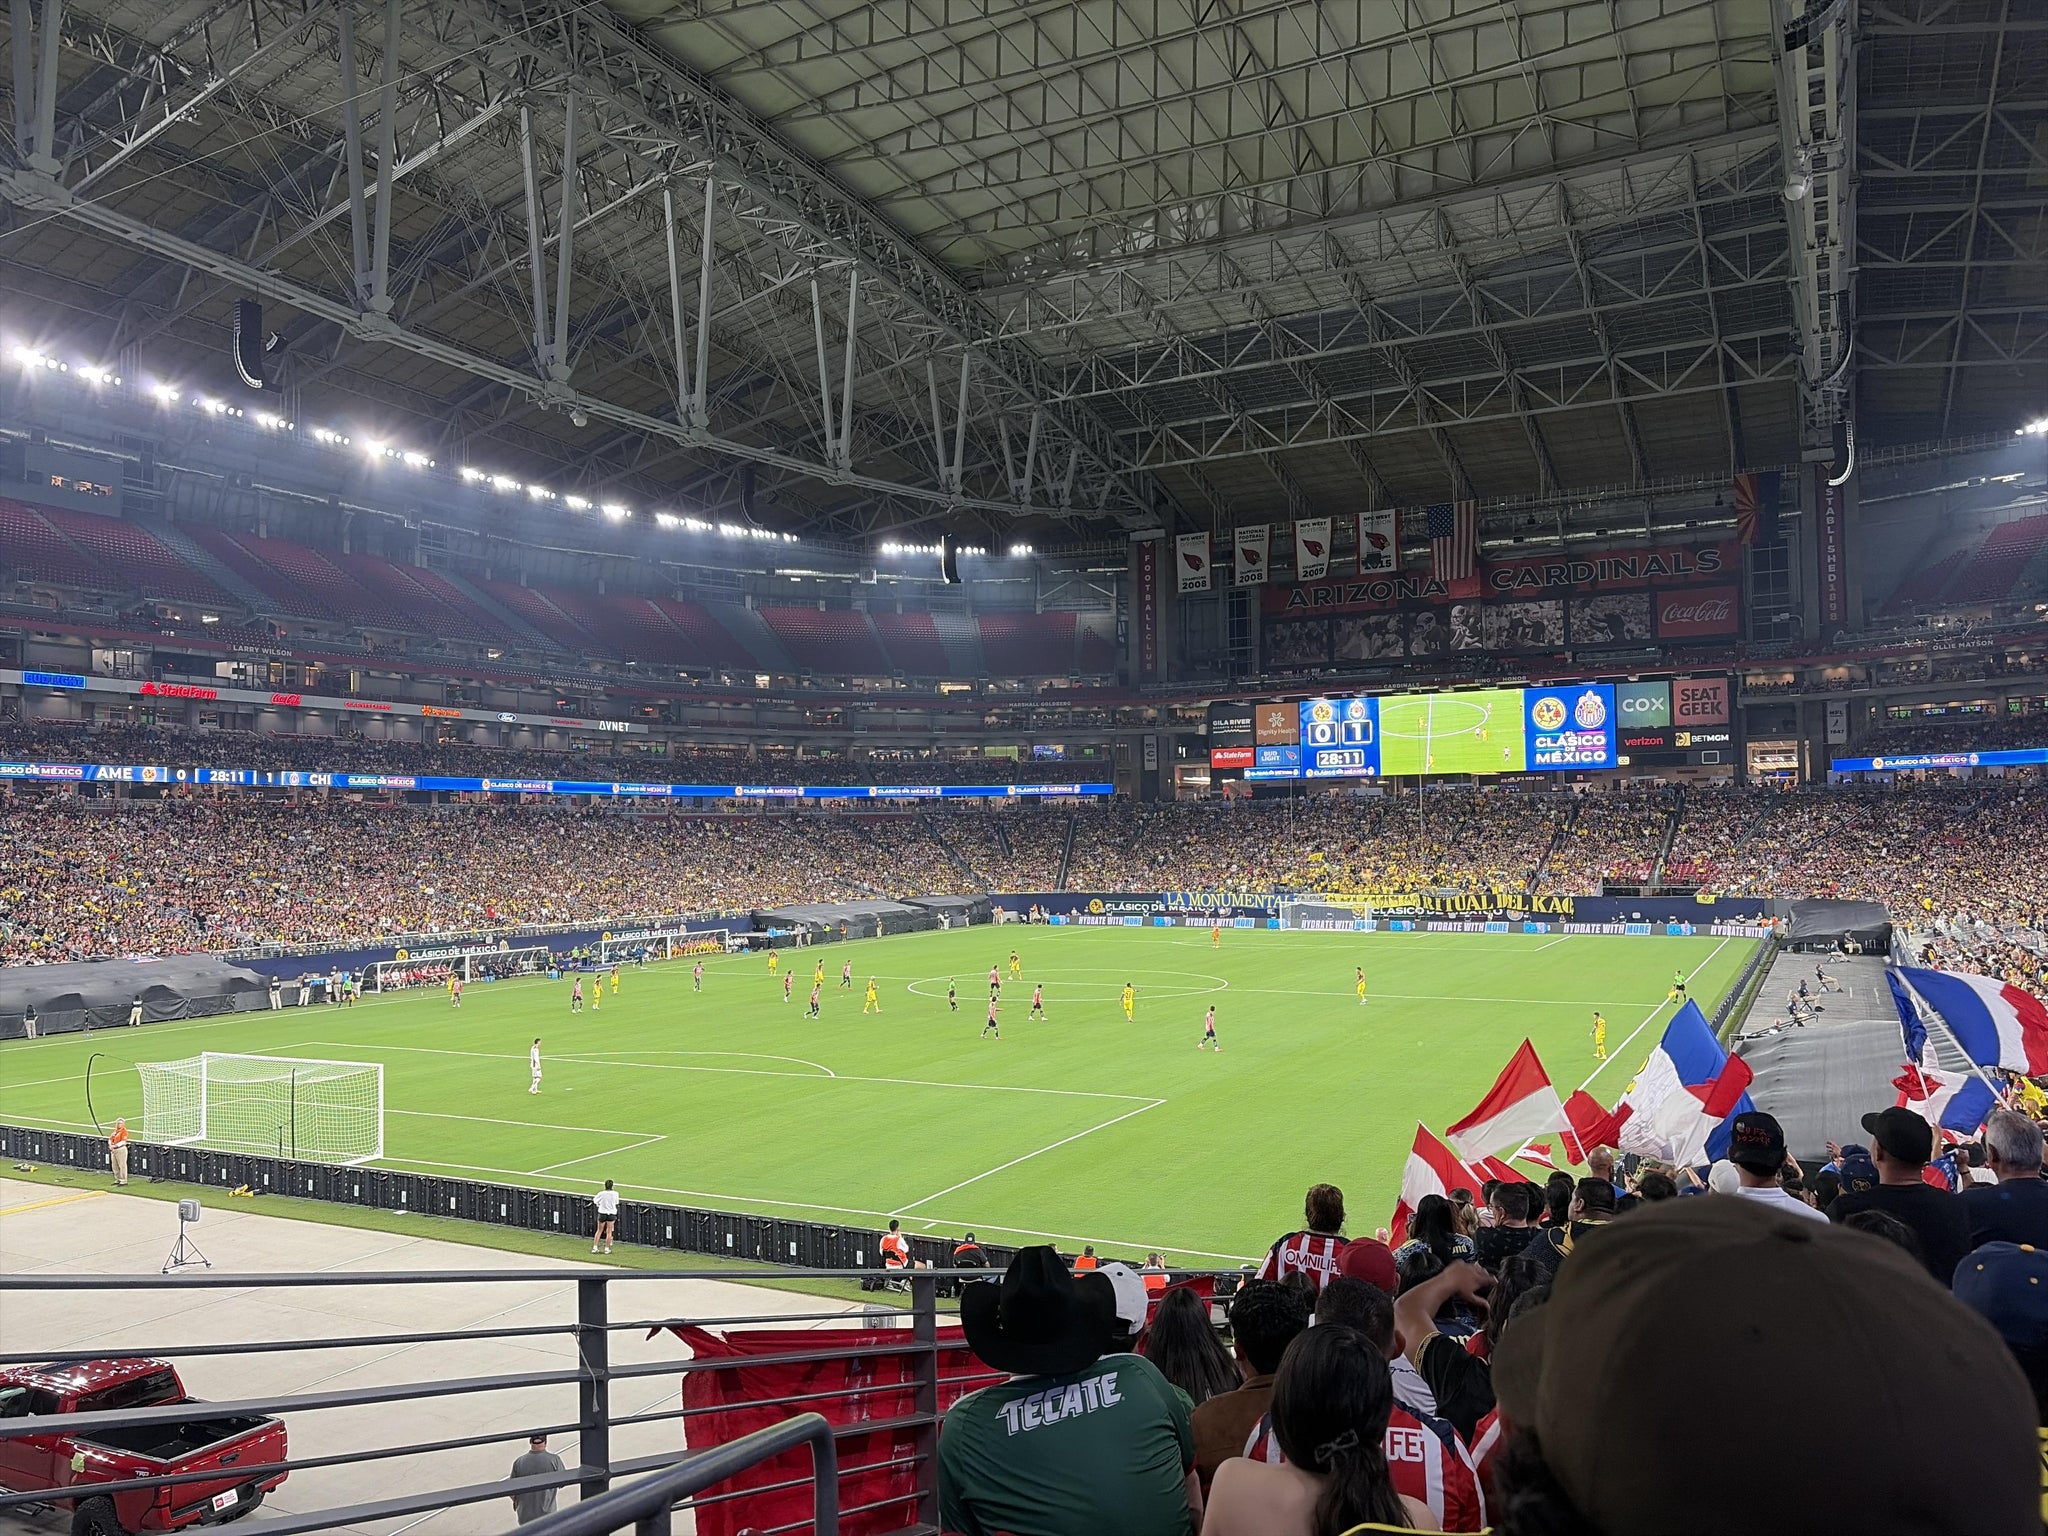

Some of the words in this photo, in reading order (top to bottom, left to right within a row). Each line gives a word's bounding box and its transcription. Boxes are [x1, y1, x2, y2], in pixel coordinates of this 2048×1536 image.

[1824, 487, 1837, 582] STABLISHED
[1302, 568, 1325, 578] 2009
[1491, 550, 1723, 591] CARDINALS
[1239, 573, 1263, 583] 2008
[1182, 580, 1207, 589] 2008
[1286, 577, 1448, 610] ARIZONA
[1958, 640, 1994, 648] MATSON
[233, 645, 259, 653] LARRY
[261, 646, 293, 657] WILSON
[1681, 687, 1720, 701] SEAT
[1622, 697, 1664, 712] COX
[1679, 701, 1723, 715] GEEK
[599, 720, 630, 732] AVNET
[1315, 724, 1331, 743] 0
[1351, 723, 1362, 741] 1
[1691, 734, 1729, 742] BETMGM
[1536, 734, 1606, 748] CLÁSICO
[1625, 737, 1664, 746] verizon
[1320, 752, 1359, 765] 28:11
[1536, 751, 1606, 763] MÉXICO
[25, 767, 39, 775] DE
[40, 766, 83, 776] MÉXICO
[97, 767, 133, 779] AME
[176, 769, 186, 780] 0
[210, 770, 244, 782] 28:11
[266, 773, 272, 783] 1
[309, 774, 331, 785] CHI
[1167, 893, 1185, 906] LA
[1423, 894, 1493, 912] RITUAL
[1497, 893, 1529, 910] DEL
[1105, 901, 1149, 911] CLÁSICO
[1151, 903, 1165, 911] DE
[1079, 916, 1107, 925] HYDRATE
[1107, 916, 1124, 925] WITH
[1185, 917, 1215, 926] HYDRATE
[1216, 917, 1234, 926] WITH
[1301, 920, 1334, 929] HYDRATE
[1334, 920, 1353, 929] WITH
[1427, 921, 1462, 931] HYDRATE
[1463, 922, 1484, 931] WITH
[1563, 923, 1600, 934] HYDRATE
[1602, 924, 1625, 934] WITH
[1626, 924, 1650, 935] MORE
[1745, 927, 1764, 937] WITH
[410, 950, 447, 959] CLÁSICO
[462, 945, 497, 954] MÉXICO
[995, 1372, 1122, 1436] TECATE
